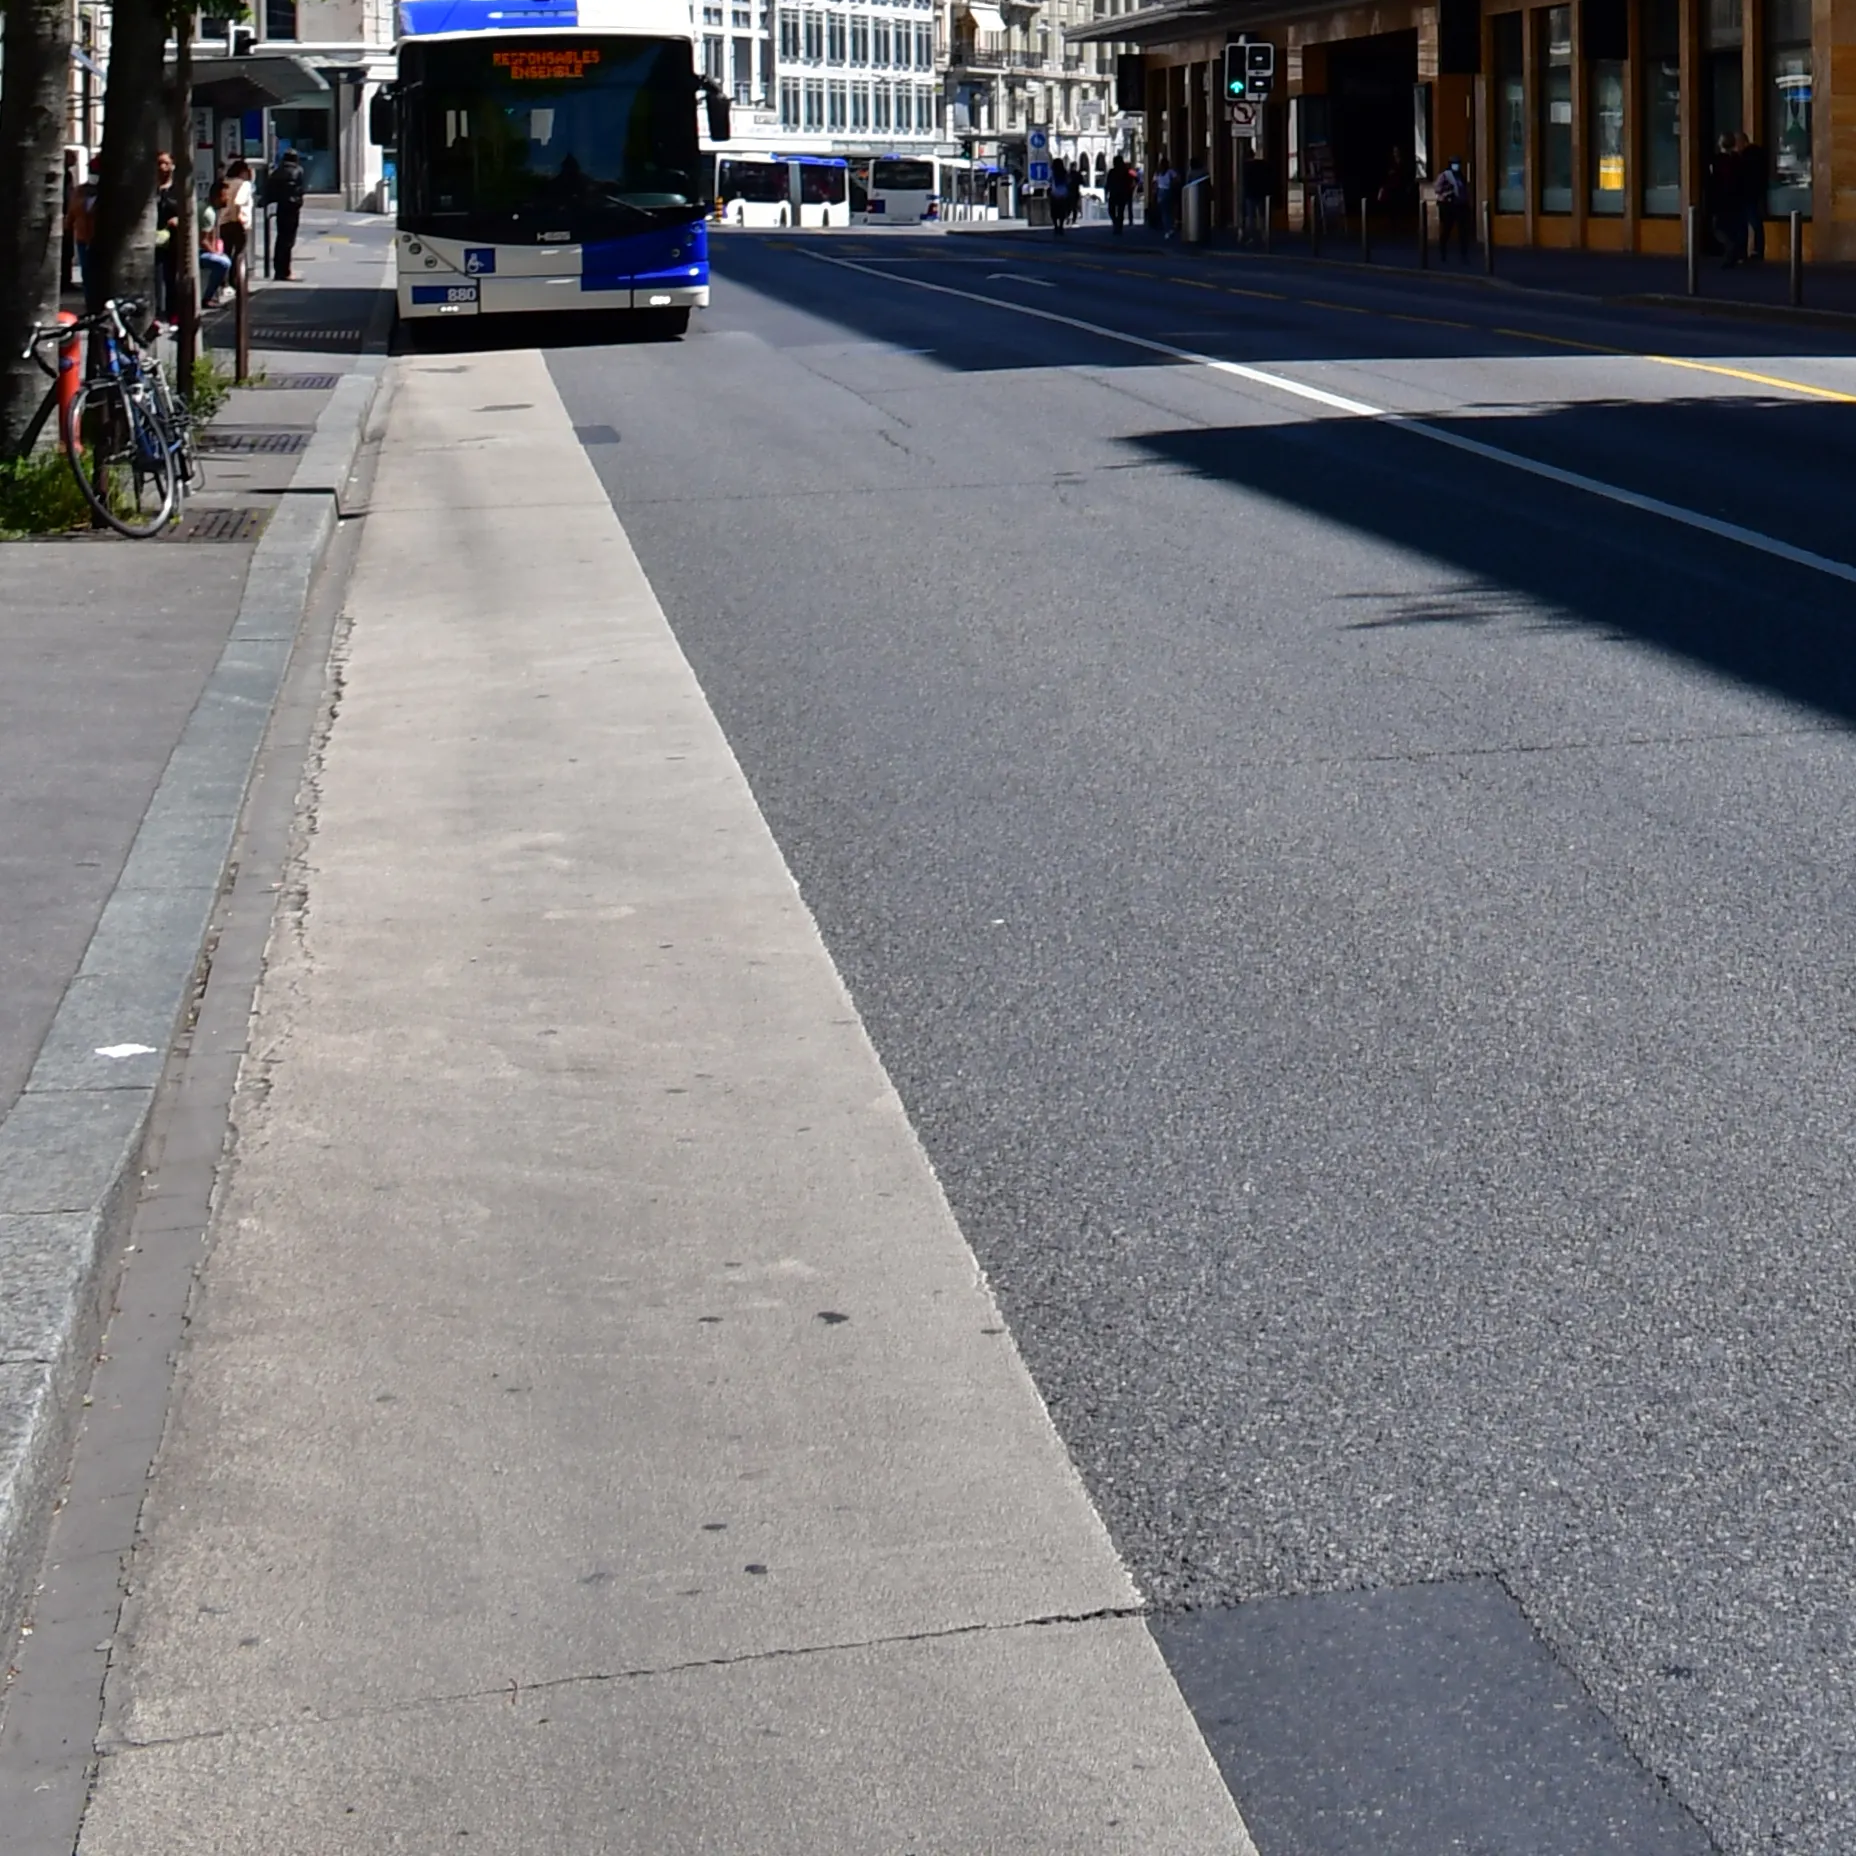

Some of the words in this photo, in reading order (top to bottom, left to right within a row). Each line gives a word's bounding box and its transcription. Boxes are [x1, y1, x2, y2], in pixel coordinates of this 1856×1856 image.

[493, 51, 600, 66] RESPONSABLES
[511, 65, 584, 78] ENSEMBLE
[447, 287, 476, 301] 880
